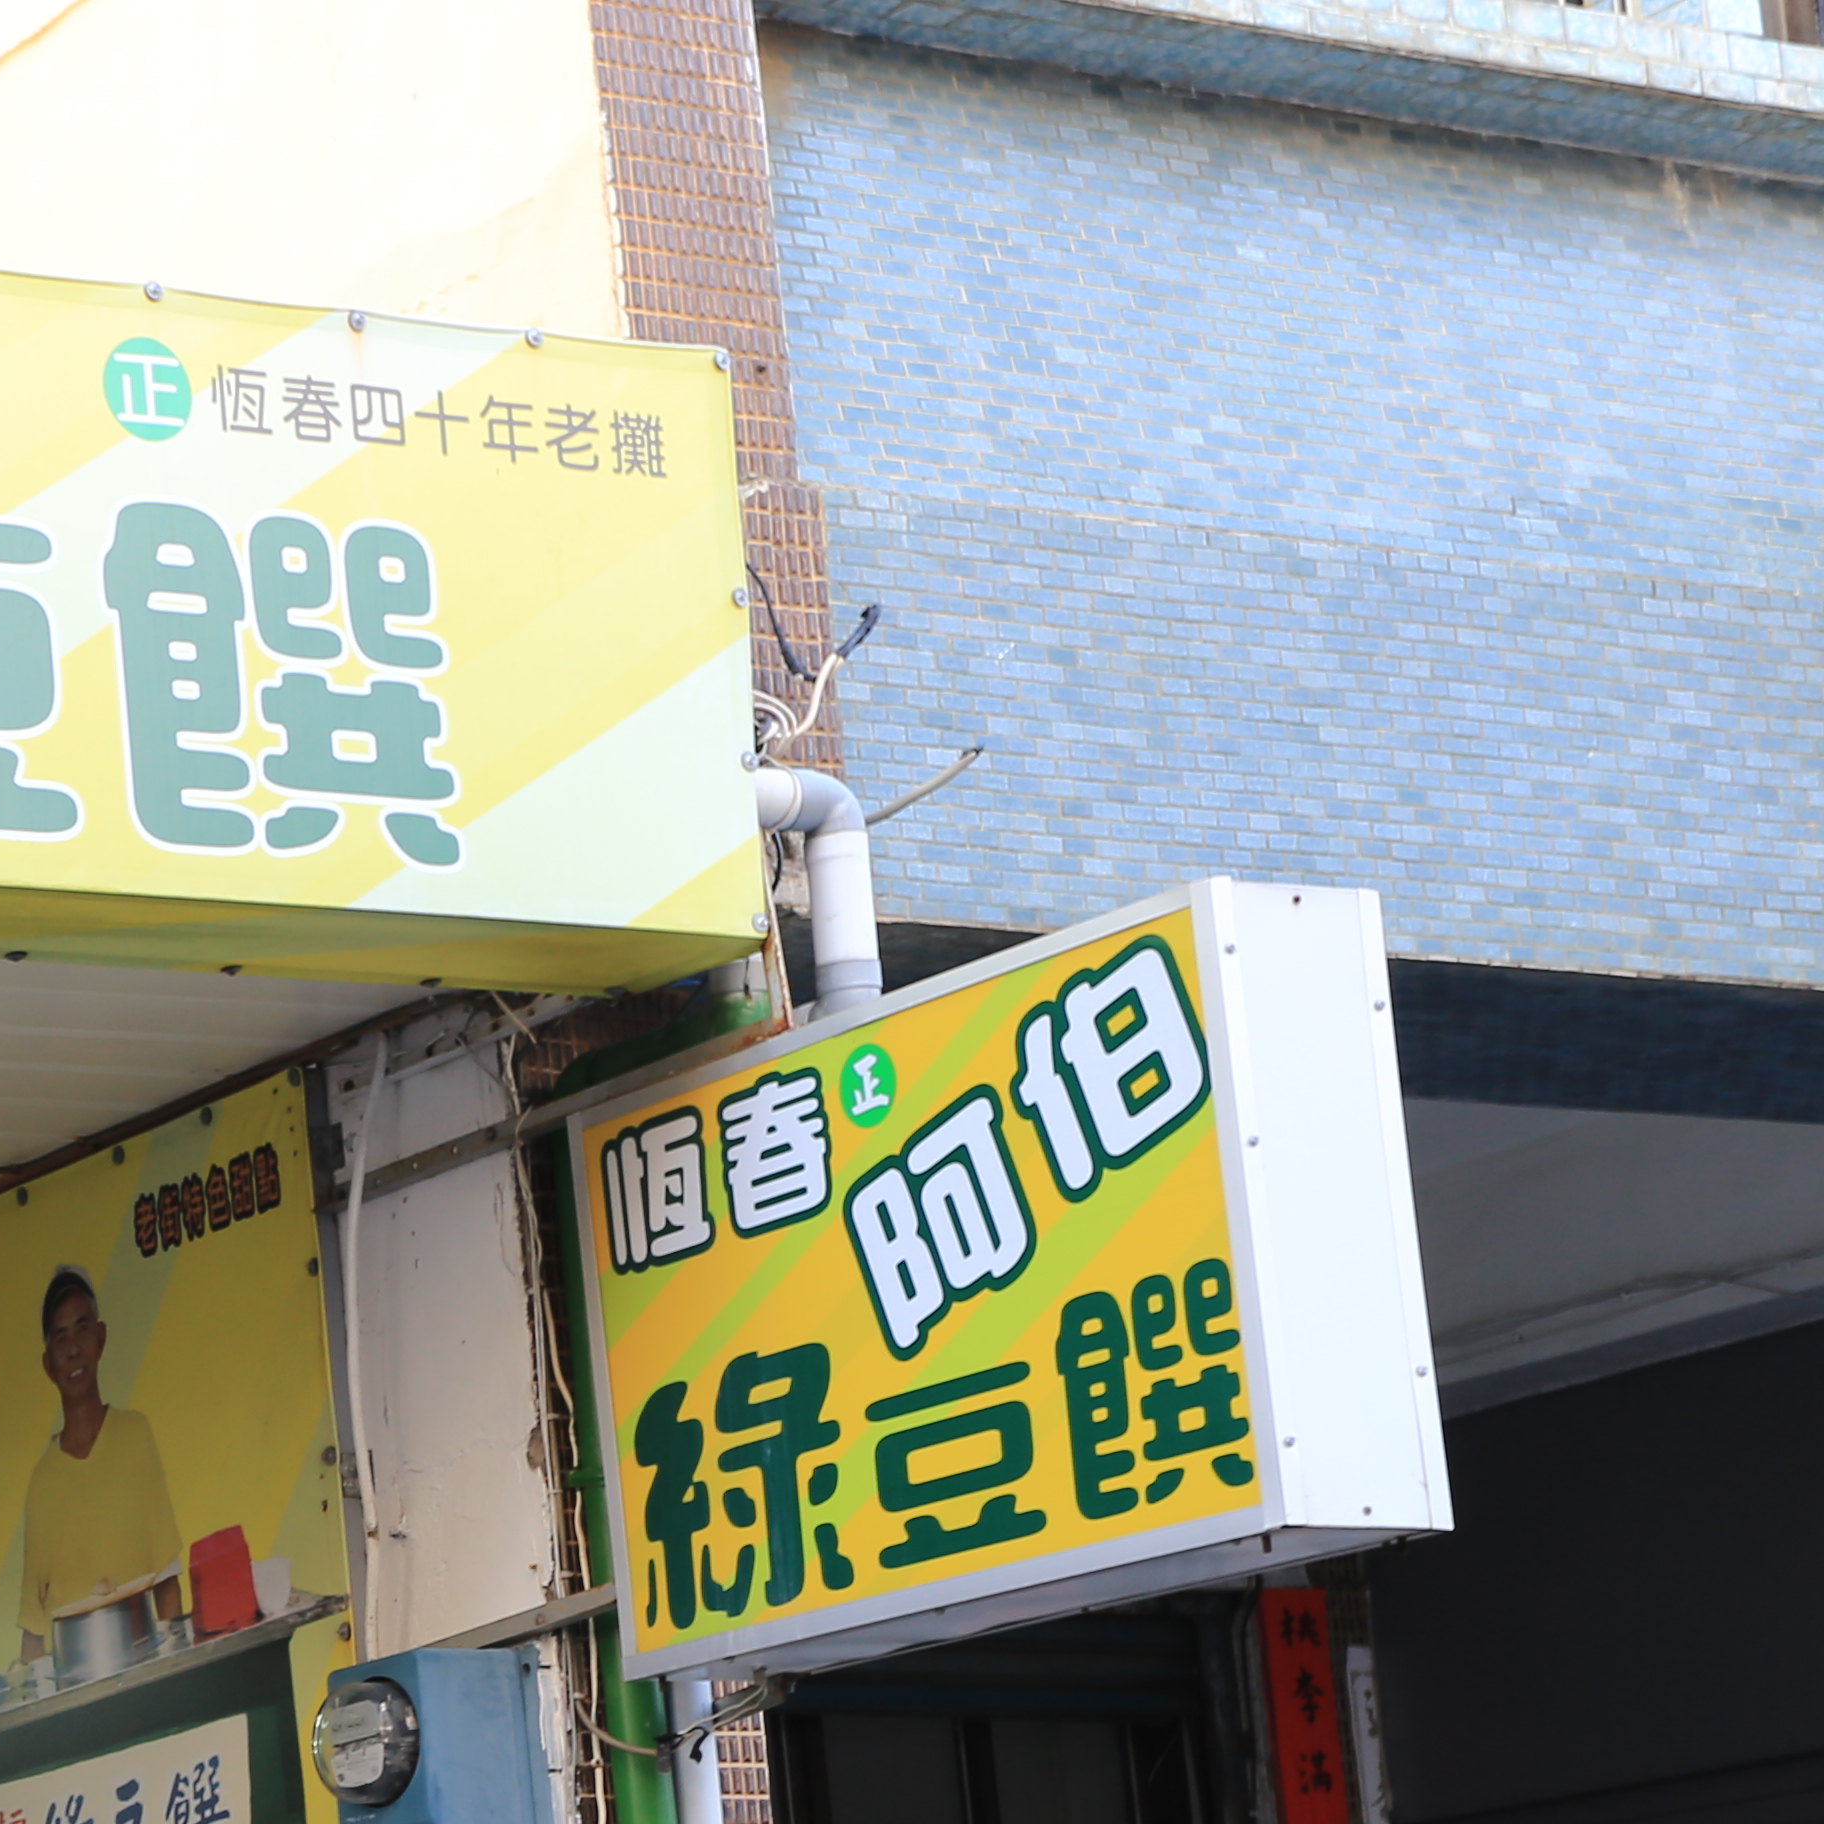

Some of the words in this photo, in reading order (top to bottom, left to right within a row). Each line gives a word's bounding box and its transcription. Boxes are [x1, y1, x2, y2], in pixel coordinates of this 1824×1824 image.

[110, 350, 187, 431] 正
[210, 363, 668, 481] 恆春四十年老攤
[601, 1067, 831, 1272] 恆春
[843, 935, 1212, 1361] 阿伯
[848, 1053, 891, 1118] 正
[635, 1258, 1254, 1630] 綠豆饌
